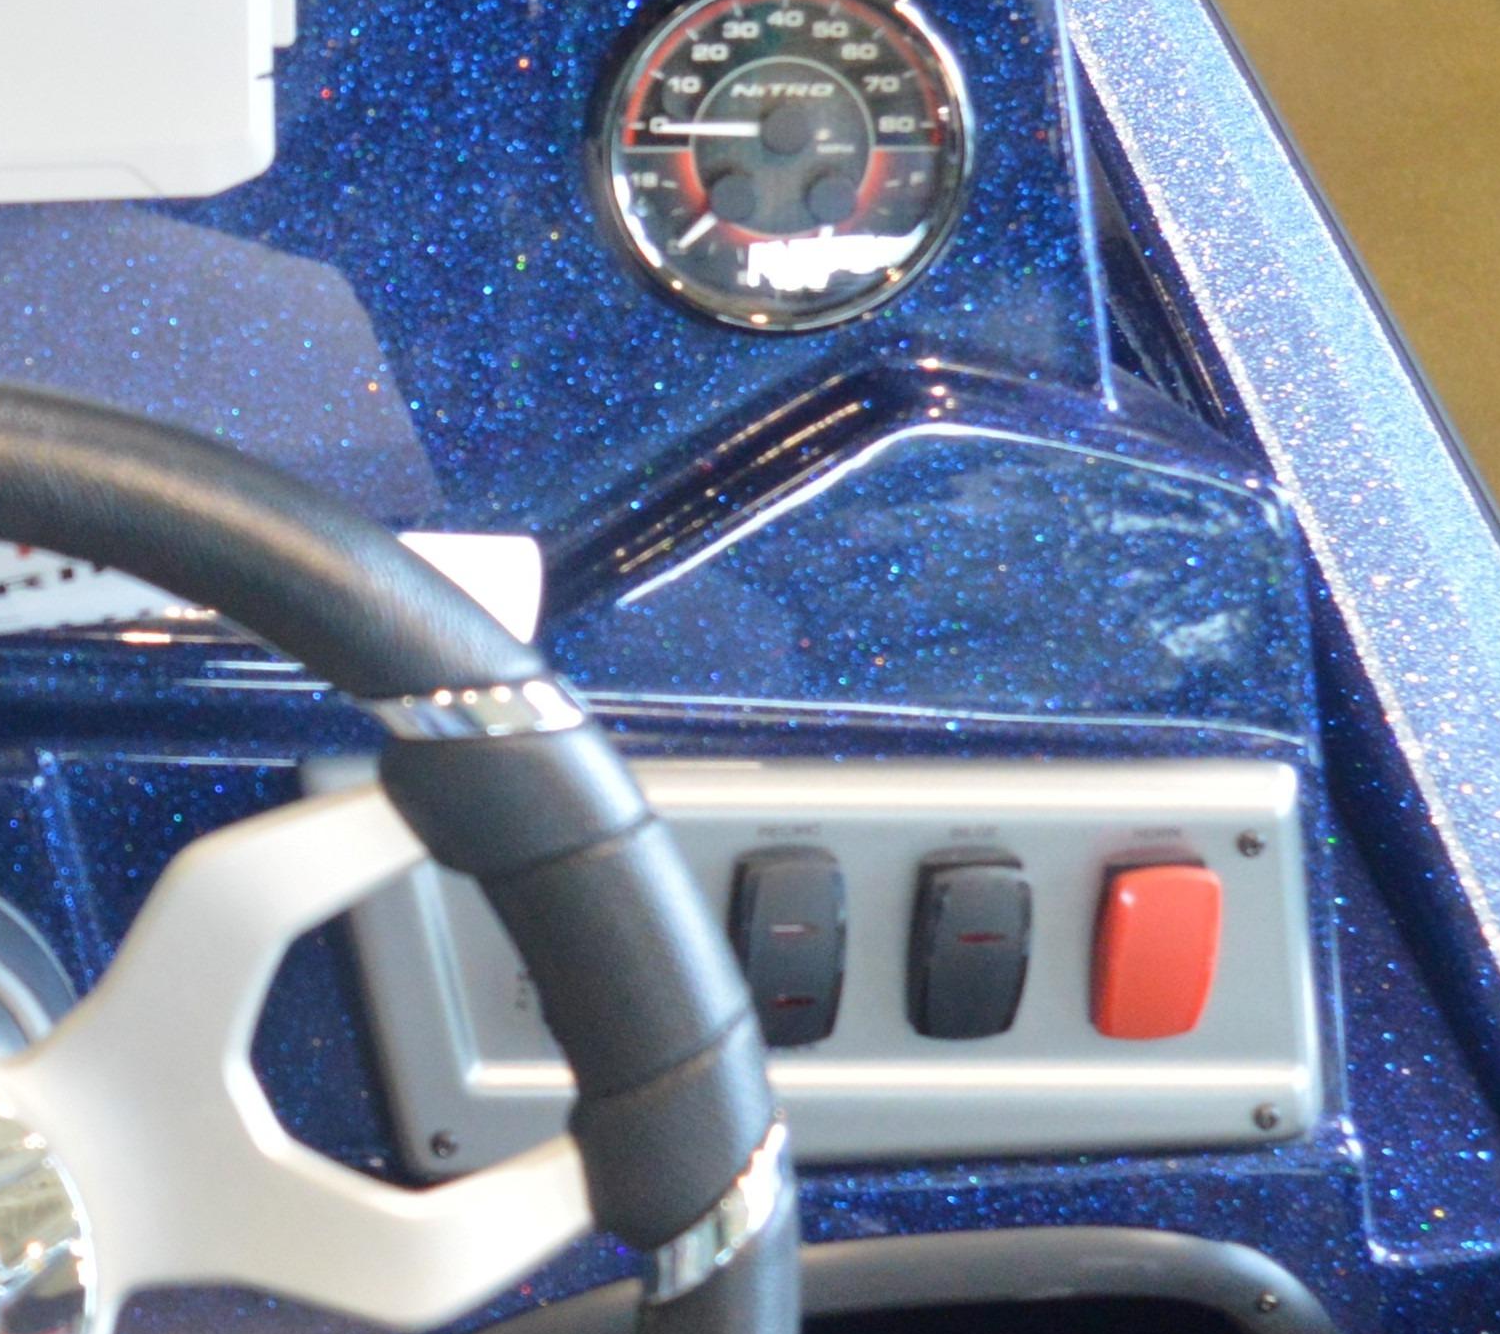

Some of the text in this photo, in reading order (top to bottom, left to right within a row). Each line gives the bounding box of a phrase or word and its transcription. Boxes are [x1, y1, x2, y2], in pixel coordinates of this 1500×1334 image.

[767, 11, 805, 27] 40
[722, 21, 760, 39] 30
[812, 21, 850, 38] 50
[691, 44, 729, 61] 20
[841, 43, 879, 60] 60
[668, 77, 701, 94] 10
[730, 83, 835, 98] NITRO
[863, 76, 900, 92] 70
[878, 116, 915, 133] 80
